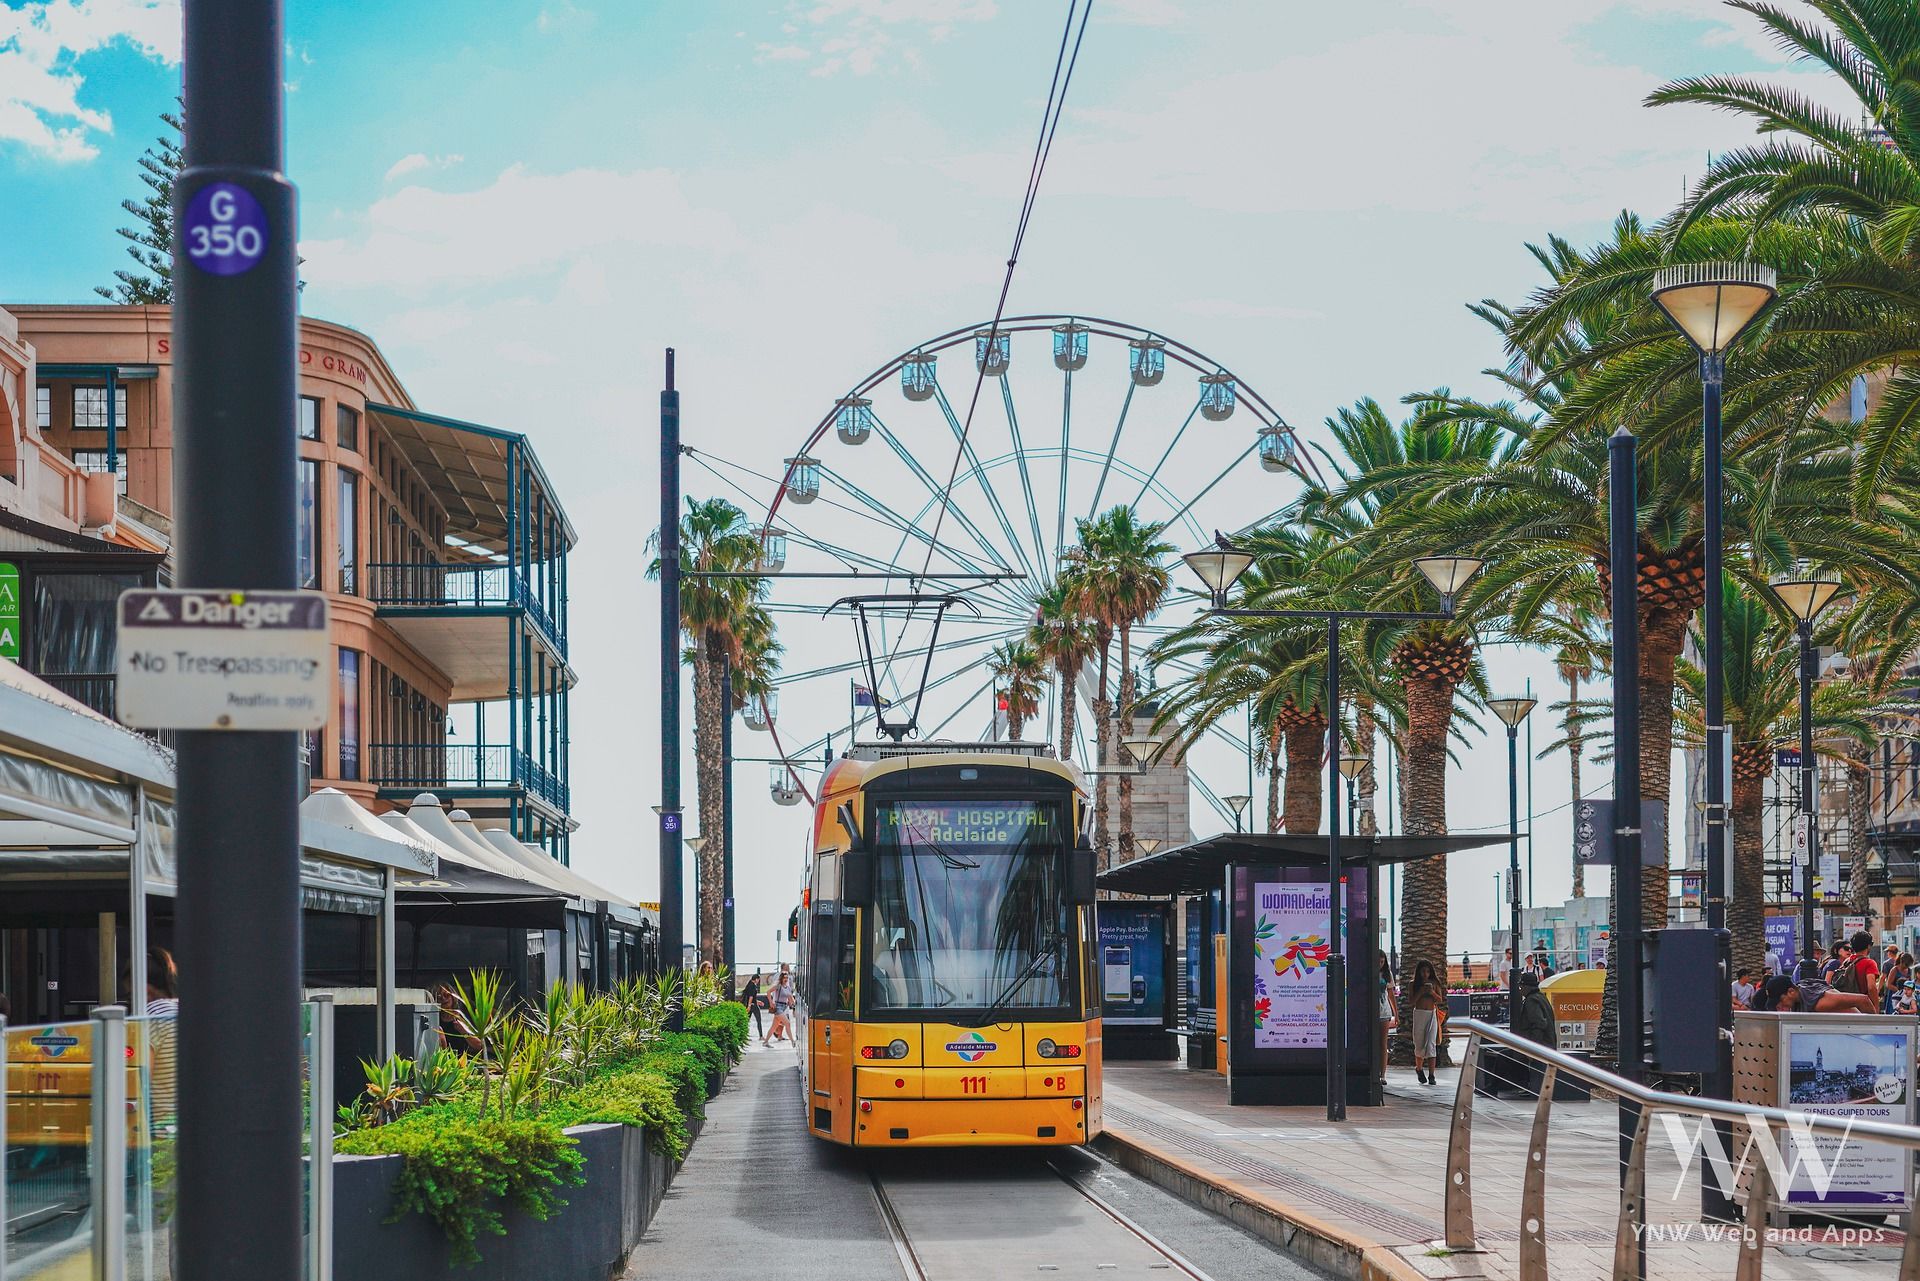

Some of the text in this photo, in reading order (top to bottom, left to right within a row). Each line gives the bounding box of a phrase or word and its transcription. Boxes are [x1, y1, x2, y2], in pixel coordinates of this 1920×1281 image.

[210, 190, 236, 222] G
[190, 225, 263, 257] 350
[180, 596, 295, 630] Danger
[132, 651, 166, 674] No
[174, 651, 316, 681] Trespassing
[889, 810, 1048, 826] ROYAL HOSPITAL
[930, 826, 1008, 842] Adelaide
[643, 902, 660, 911] TAX
[1262, 893, 1331, 910] WOMADelaid
[1099, 926, 1116, 934] Apple
[1559, 1003, 1599, 1012] RECYCLING
[960, 1076, 987, 1094] 111
[1056, 1076, 1066, 1091] B
[1837, 1108, 1865, 1116] GUIDED
[1866, 1108, 1890, 1116] TOURS
